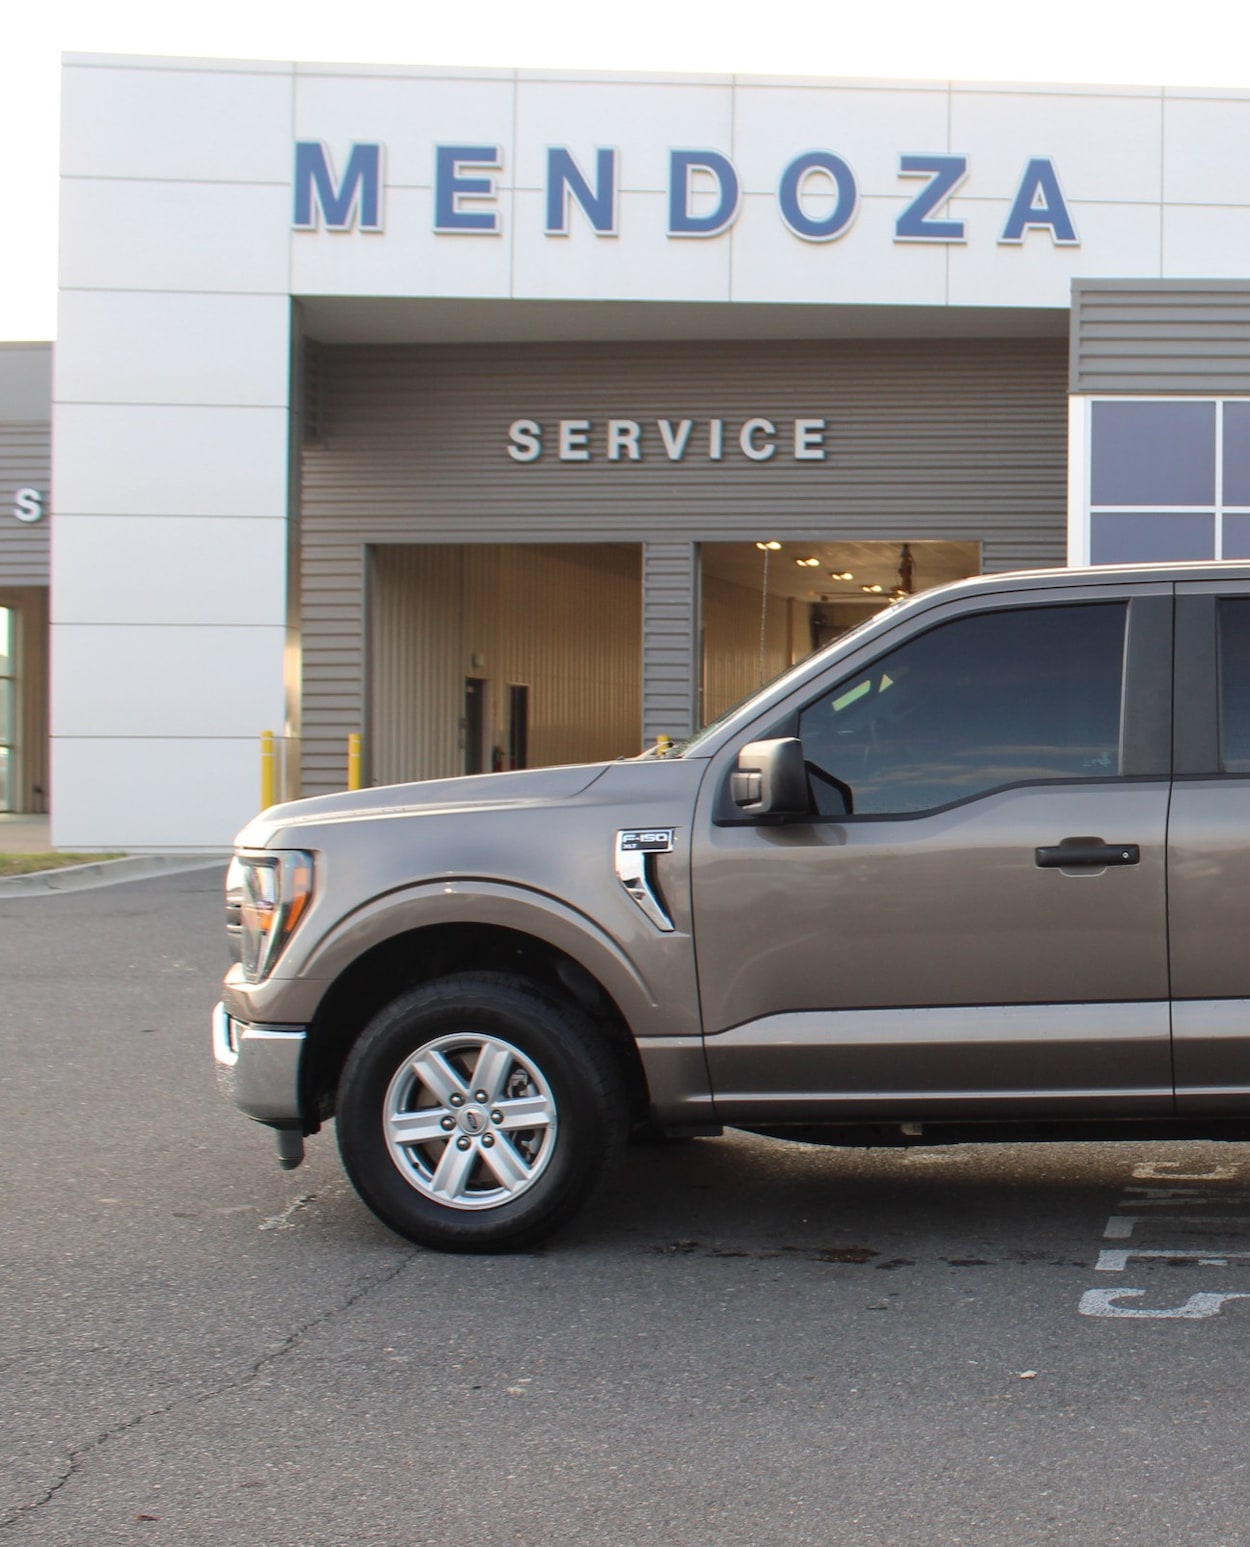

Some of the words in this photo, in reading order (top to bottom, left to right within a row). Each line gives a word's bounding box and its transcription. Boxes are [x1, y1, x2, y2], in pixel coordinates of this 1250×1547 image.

[292, 138, 1081, 248] MENDOZA
[506, 416, 830, 464] SERVICE
[622, 832, 668, 843] F-150
